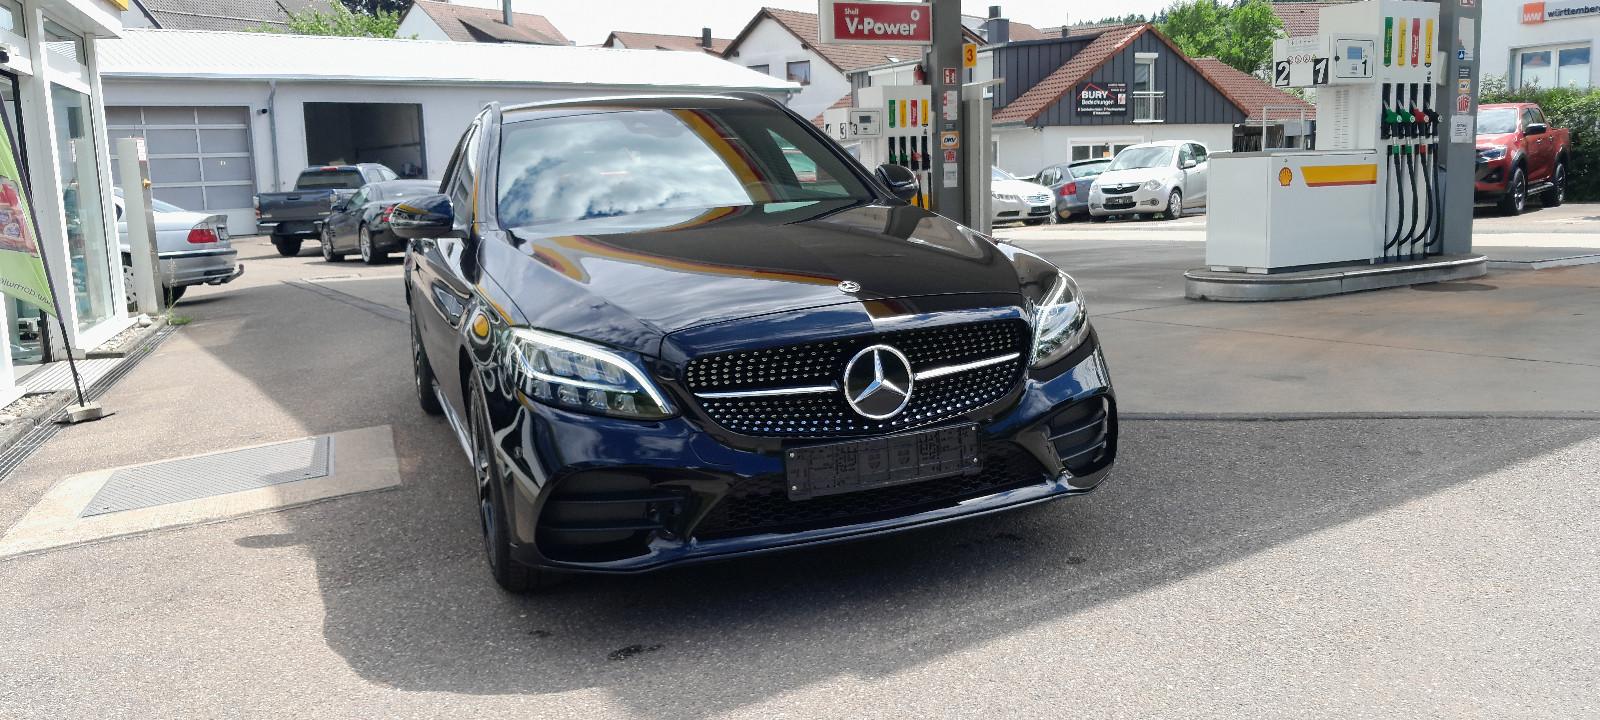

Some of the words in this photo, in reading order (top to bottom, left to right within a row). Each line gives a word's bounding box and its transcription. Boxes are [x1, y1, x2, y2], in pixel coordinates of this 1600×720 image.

[845, 17, 917, 36] V-Power
[966, 48, 974, 63] 3
[1275, 61, 1290, 86] 2
[1315, 58, 1327, 83] 1
[1361, 59, 1368, 76] 1
[1081, 90, 1109, 99] BURY
